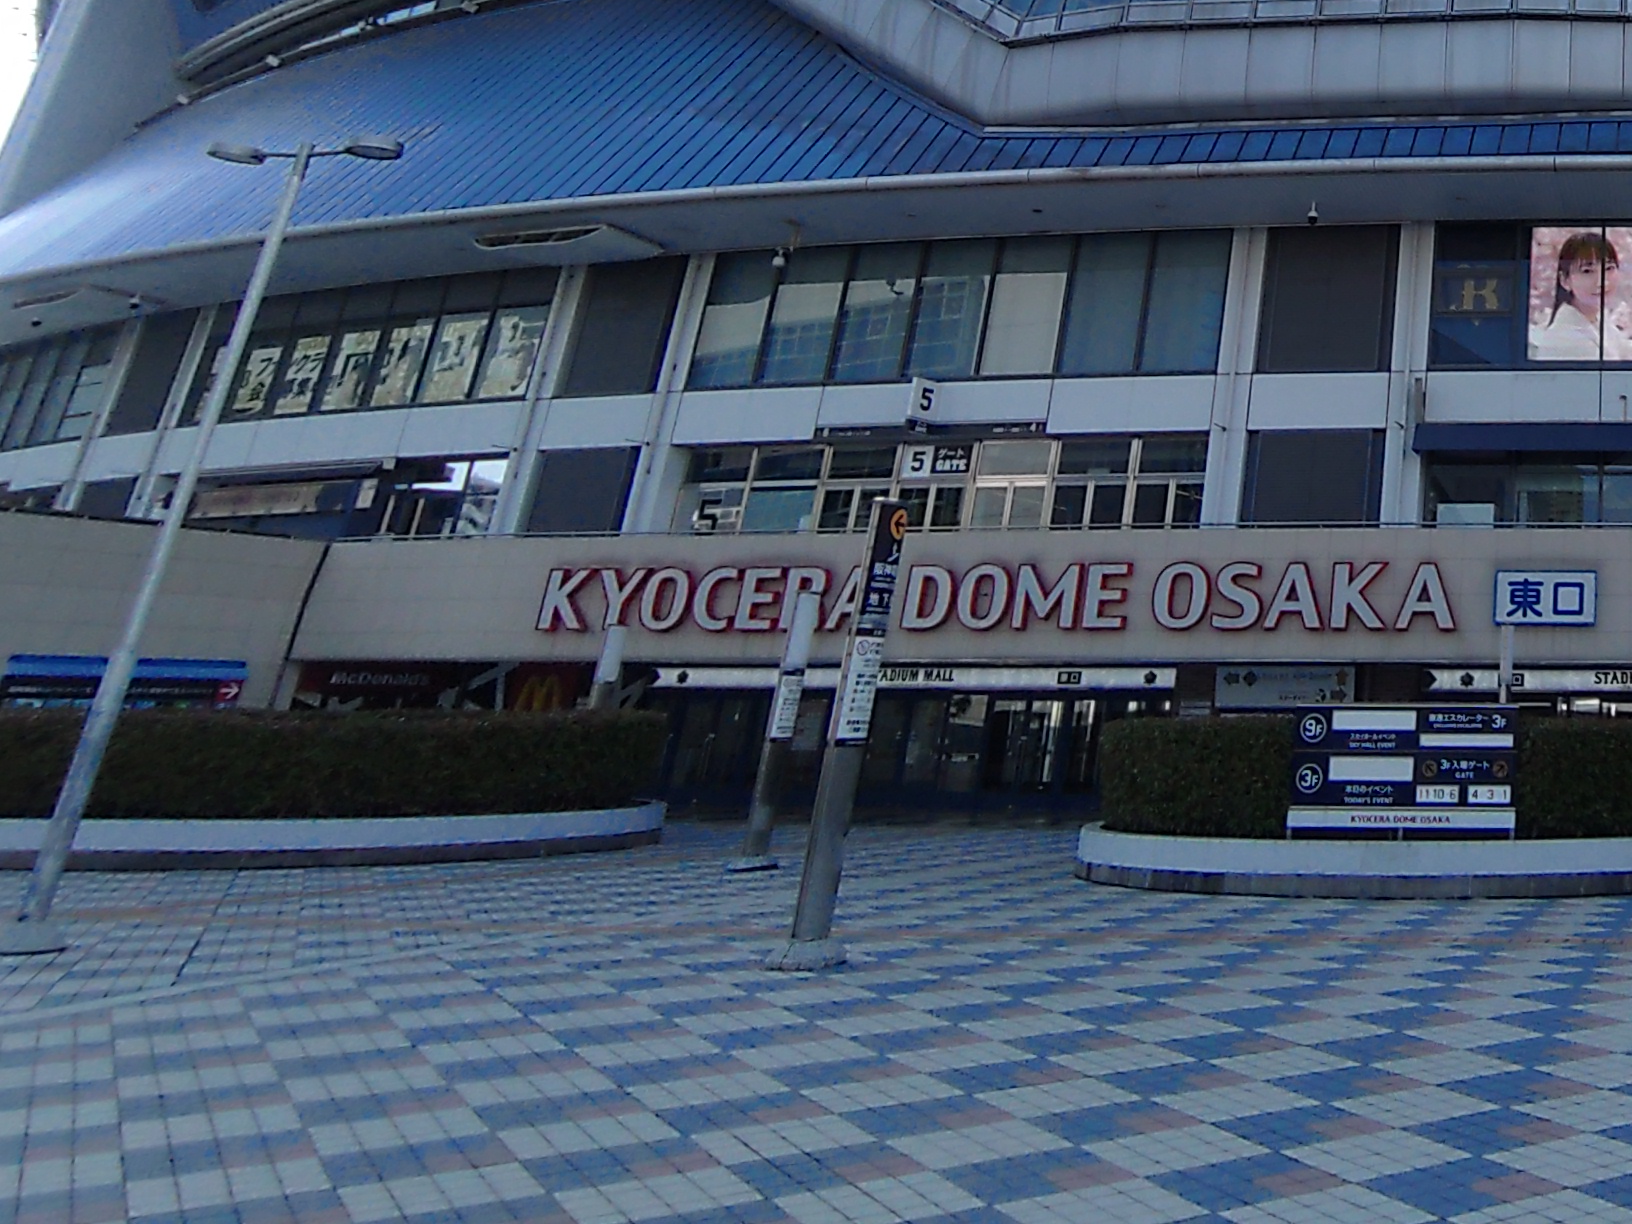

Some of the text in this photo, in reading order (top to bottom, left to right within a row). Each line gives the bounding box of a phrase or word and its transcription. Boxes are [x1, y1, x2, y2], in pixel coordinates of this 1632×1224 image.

[919, 387, 935, 412] 5
[910, 451, 968, 472] 5 GATE
[937, 448, 965, 458] ゲート
[695, 498, 723, 536] 5
[900, 561, 1134, 633] DOME
[1151, 560, 1457, 632] OSAKA
[1505, 577, 1585, 618] 東口
[877, 668, 955, 684] ADIUM MALL
[1305, 719, 1323, 736] 9F
[1491, 714, 1508, 729] 3F
[1300, 769, 1319, 787] 3F
[1455, 771, 1475, 780] GATE
[1372, 796, 1394, 804] EVENT
[1350, 815, 1451, 824] KYOCERA DOME OSAKA
